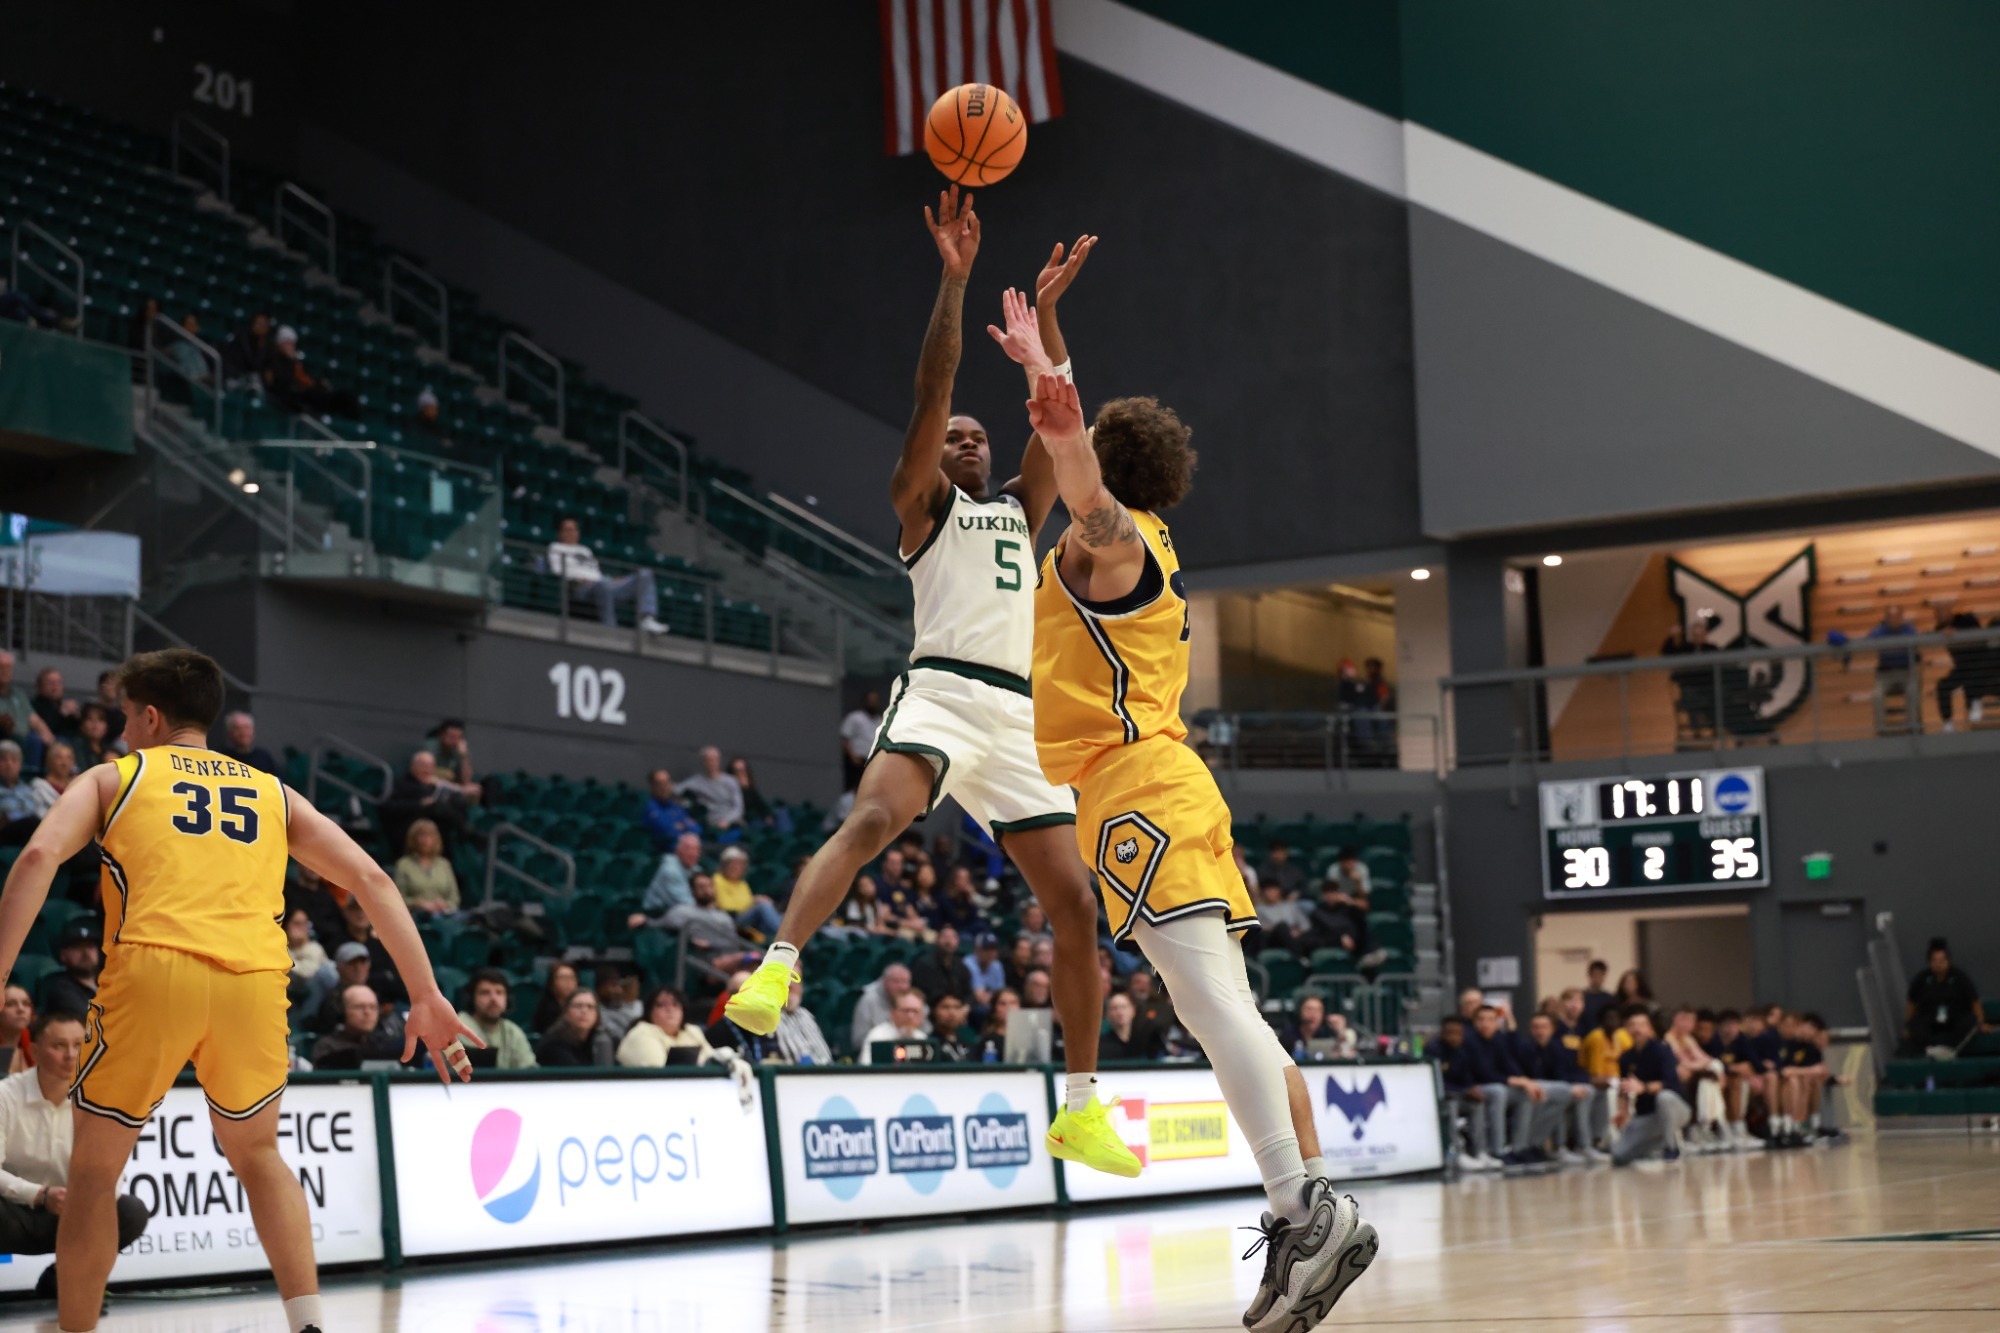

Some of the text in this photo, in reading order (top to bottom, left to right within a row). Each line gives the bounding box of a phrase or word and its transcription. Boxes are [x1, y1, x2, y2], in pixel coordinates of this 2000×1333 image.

[193, 63, 253, 116] 201
[995, 539, 1021, 592] 5
[548, 662, 626, 725] 102
[170, 754, 252, 778] DENKER
[172, 781, 258, 844] 35
[1613, 778, 1702, 818] 17:11
[1564, 847, 1610, 888] 30
[1643, 847, 1665, 879] 2
[1711, 838, 1758, 879] 35
[805, 1124, 874, 1158] OnPoint
[889, 1121, 953, 1154] OnPoint
[966, 1118, 1027, 1150] OnPoint
[558, 1117, 699, 1206] pepsi
